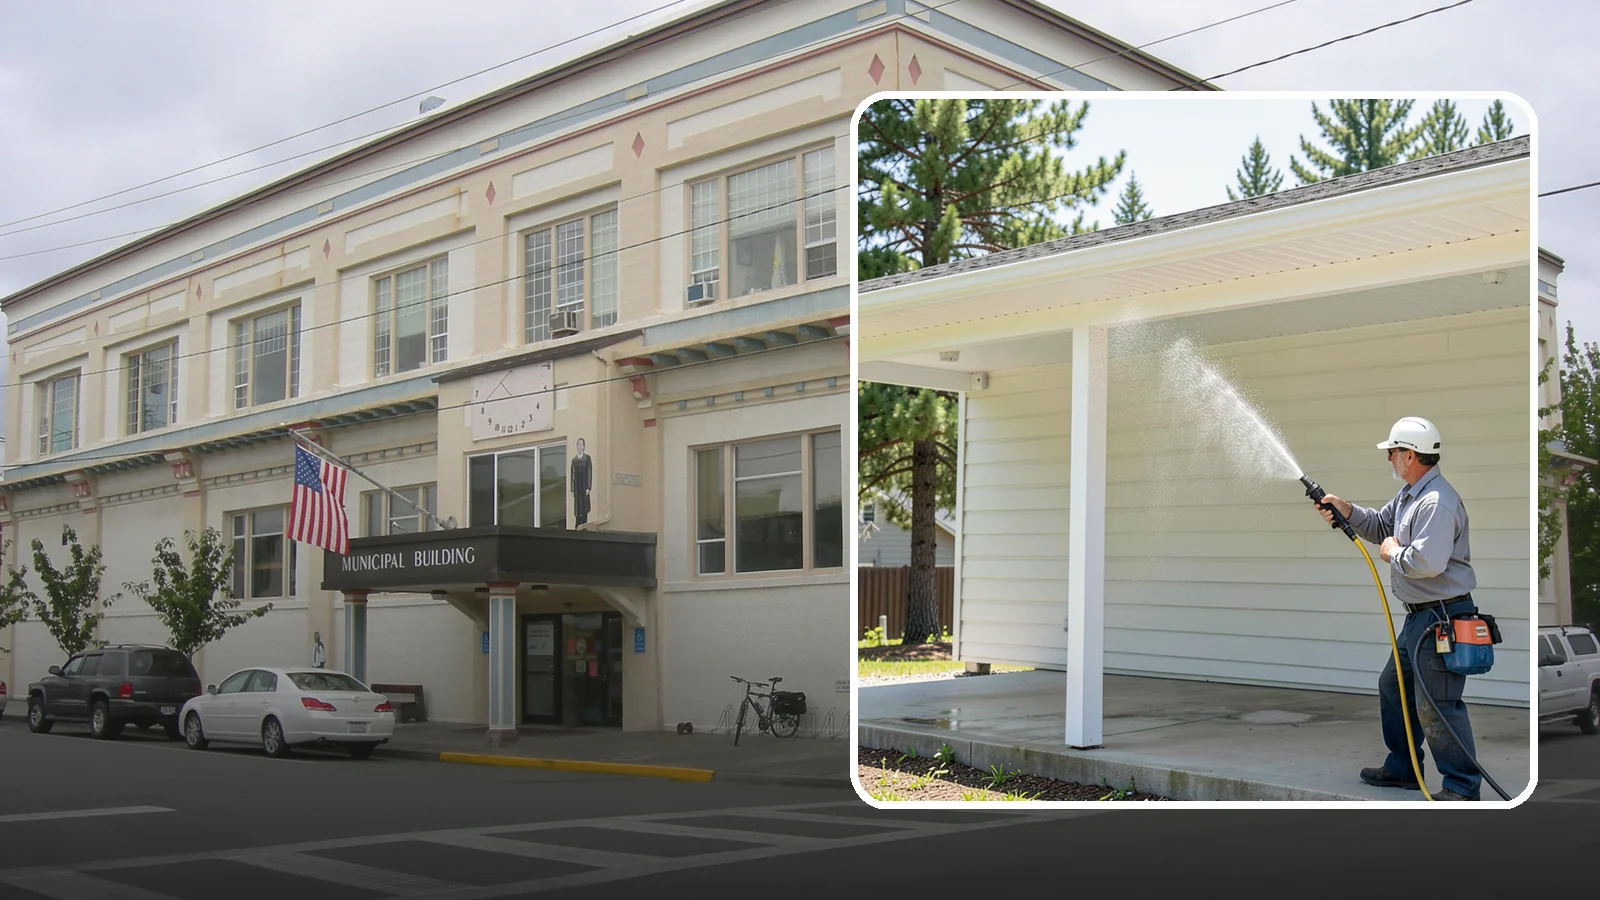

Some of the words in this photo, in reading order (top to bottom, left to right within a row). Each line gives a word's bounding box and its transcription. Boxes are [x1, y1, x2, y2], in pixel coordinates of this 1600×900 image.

[536, 402, 540, 410] 4
[480, 406, 484, 415] 8
[488, 418, 492, 426] 9
[529, 414, 533, 422] 3
[494, 424, 500, 432] 10
[521, 420, 525, 428] 2
[508, 426, 514, 434] 12
[342, 552, 405, 572] MUNICIPAL
[414, 546, 475, 567] BUILDING
